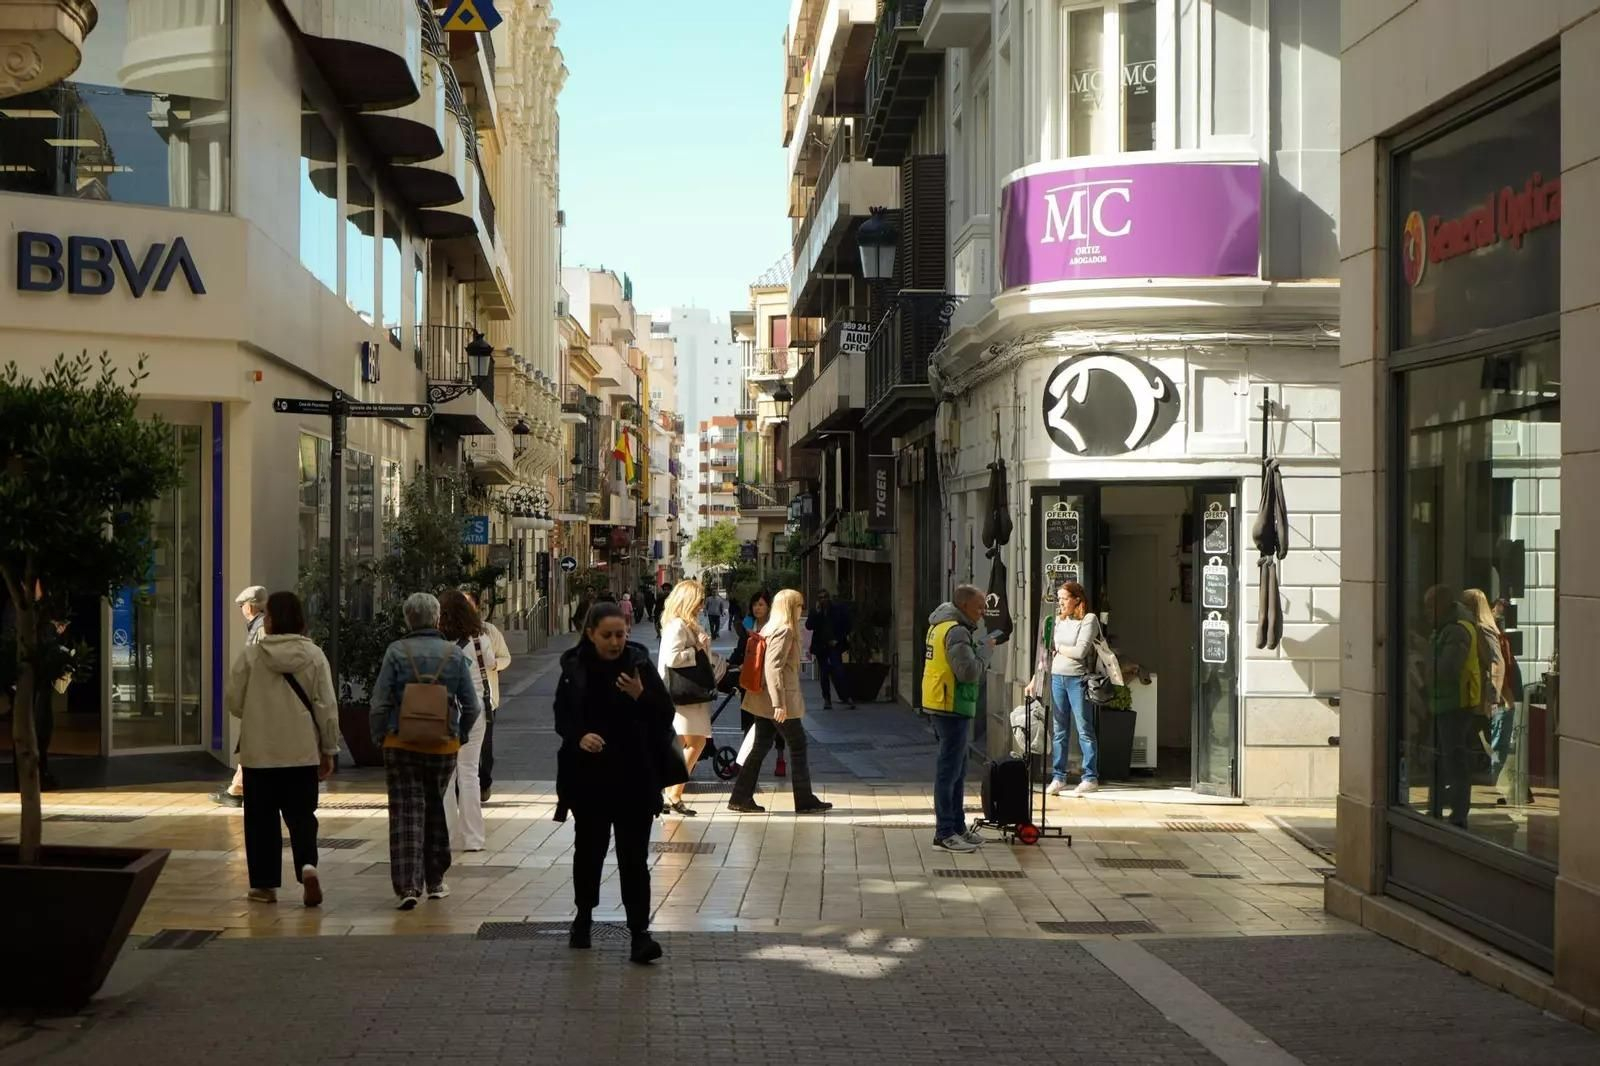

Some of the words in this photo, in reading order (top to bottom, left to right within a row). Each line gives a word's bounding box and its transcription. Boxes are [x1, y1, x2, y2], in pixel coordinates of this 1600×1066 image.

[1075, 246, 1101, 256] ORTIZ
[17, 231, 207, 299] BBVA
[1069, 256, 1107, 265] ABOGADOS
[876, 469, 887, 518] TIGER
[464, 534, 484, 543] ATM
